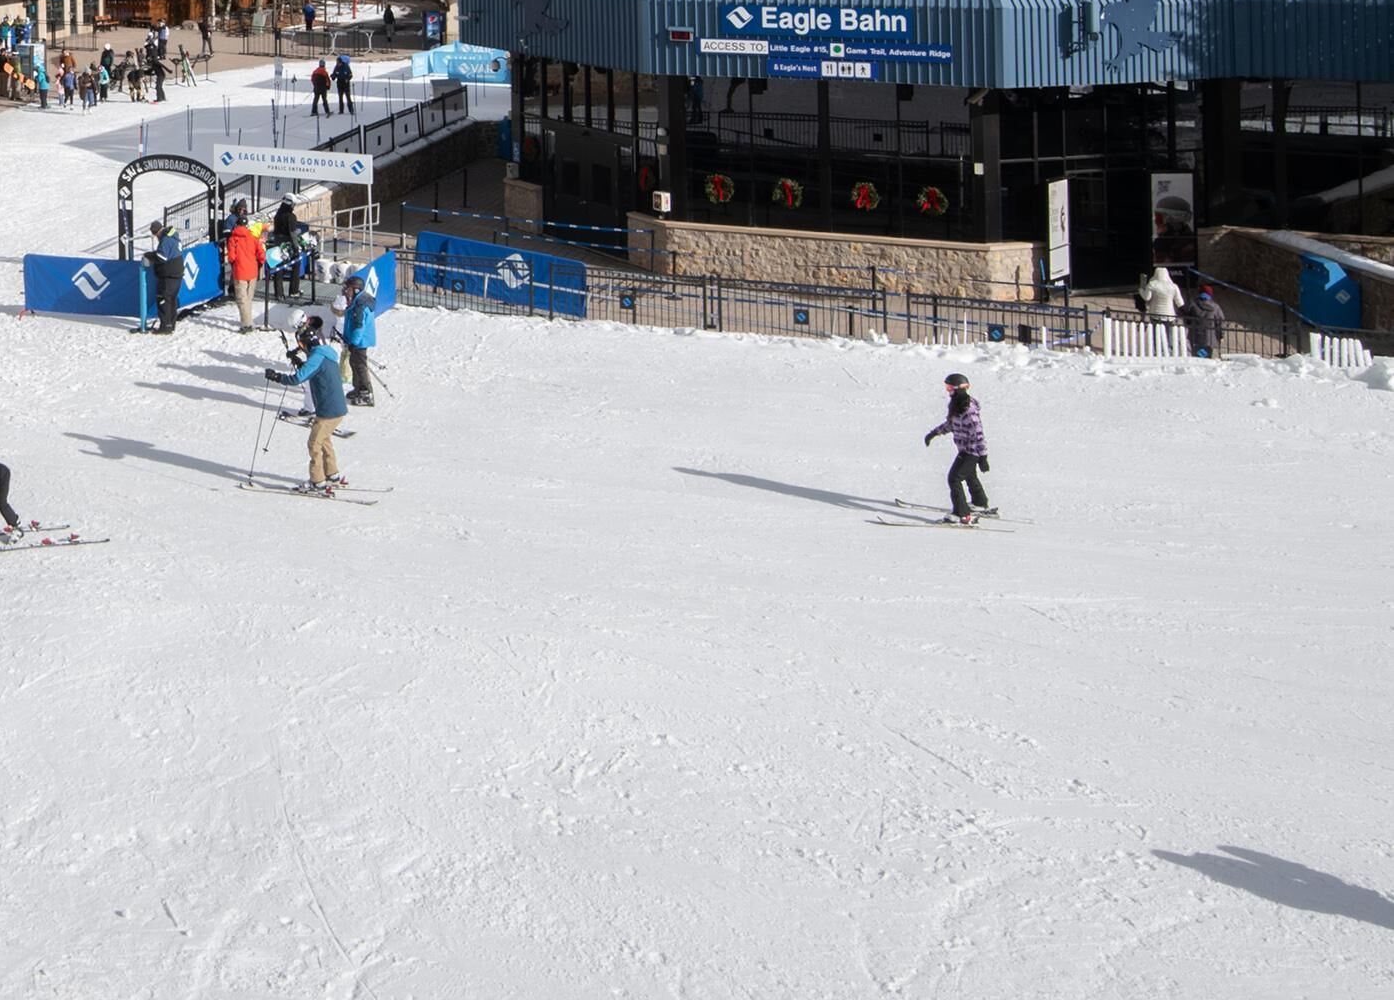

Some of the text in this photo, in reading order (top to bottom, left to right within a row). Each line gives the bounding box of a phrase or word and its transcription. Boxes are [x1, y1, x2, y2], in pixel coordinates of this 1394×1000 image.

[761, 6, 908, 35] Eagle Bahn
[703, 41, 767, 52] ACCESS TO:
[770, 44, 788, 52] Little
[790, 44, 811, 53] Eagle
[846, 47, 868, 55] Game
[869, 48, 887, 56] Trail,
[889, 49, 927, 57] Adventure
[929, 50, 951, 59] Ridge
[780, 64, 801, 72] Eagle's
[238, 152, 346, 168] EAGLE BAHN GONDOLA
[122, 165, 136, 182] SKI
[135, 162, 144, 174] &
[143, 158, 189, 172] SNOWBOARD
